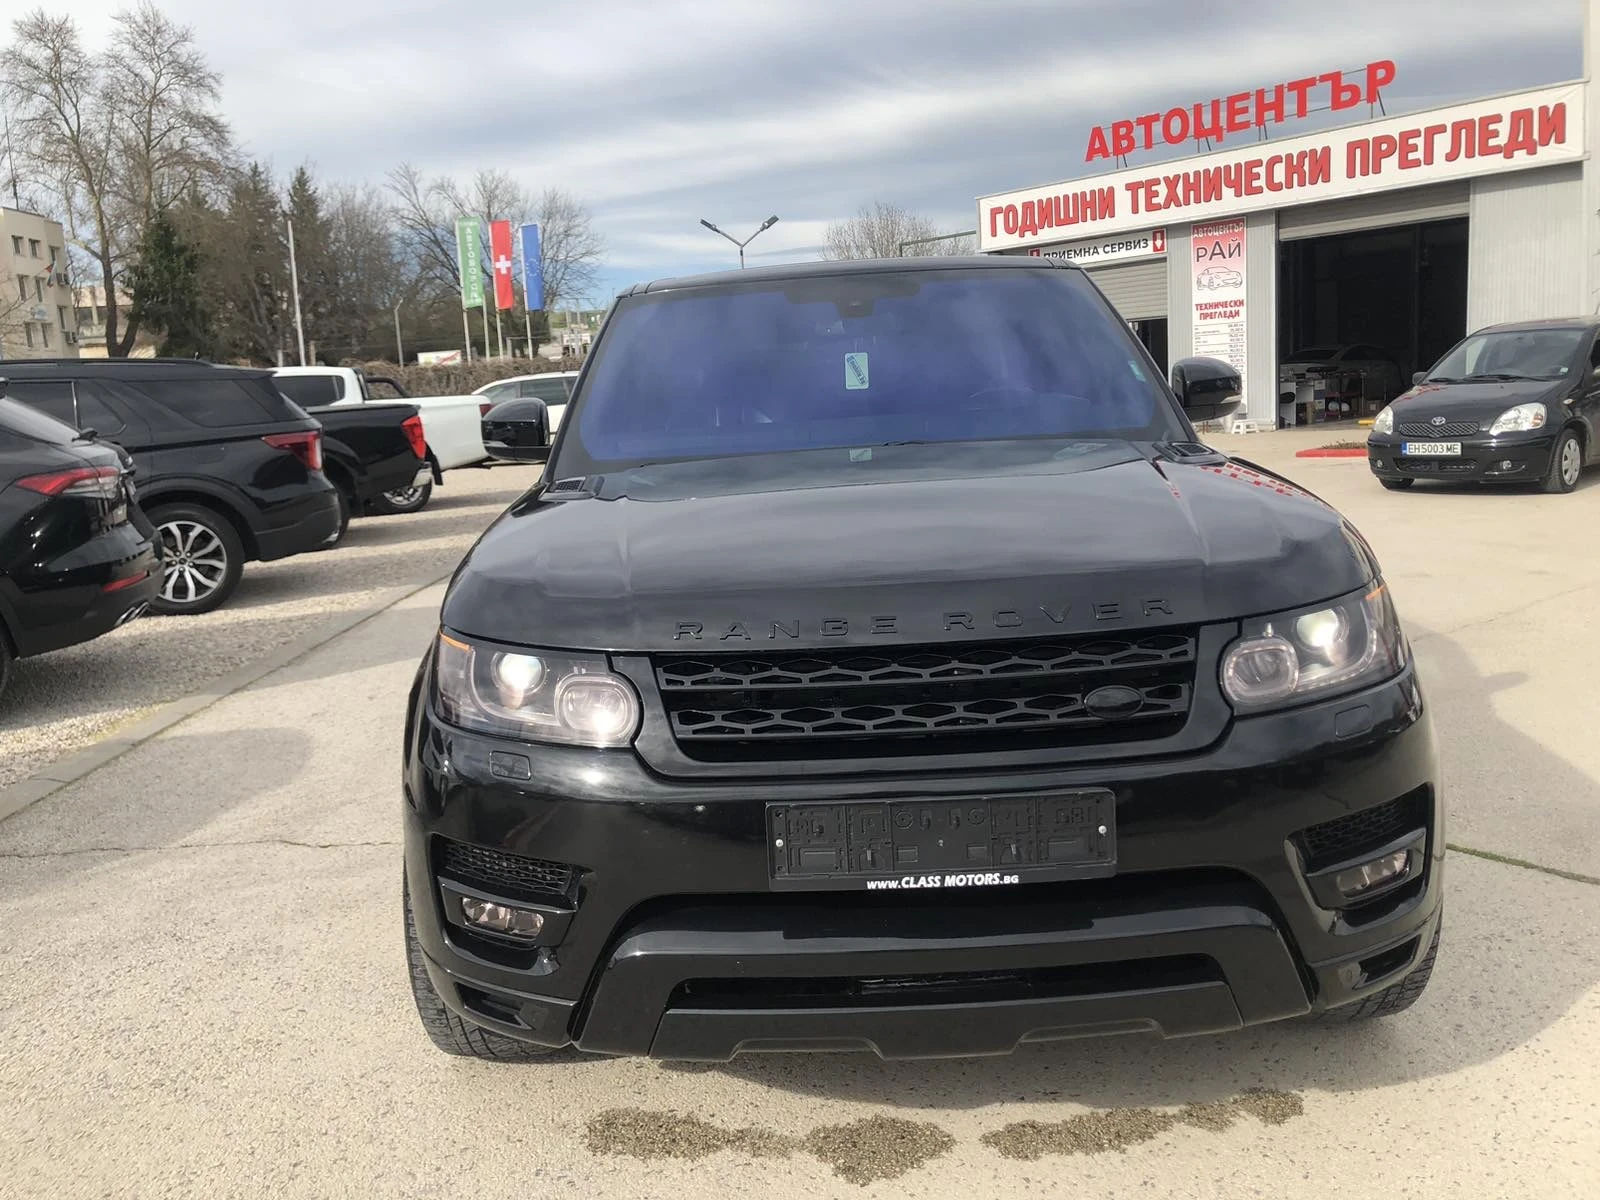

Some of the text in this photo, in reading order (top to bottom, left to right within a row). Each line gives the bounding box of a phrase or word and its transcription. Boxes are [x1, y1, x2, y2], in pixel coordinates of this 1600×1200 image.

[1085, 60, 1396, 162] АВТОЦЕНТЪР
[990, 102, 1567, 237] ГОДИШНИ ТЕХНИЧЕСКИ ПРЕГЛЕДИ
[1193, 222, 1244, 238] АВТОЦЕНТЪР
[1102, 238, 1149, 254] СЕРВИЗ
[1196, 238, 1241, 263] РАЙ
[1195, 299, 1245, 311] ТЕХНИЧЕСКИ
[1199, 309, 1240, 321] ПРЕГЛЕДИ
[673, 599, 1174, 641] RANGE ROVER
